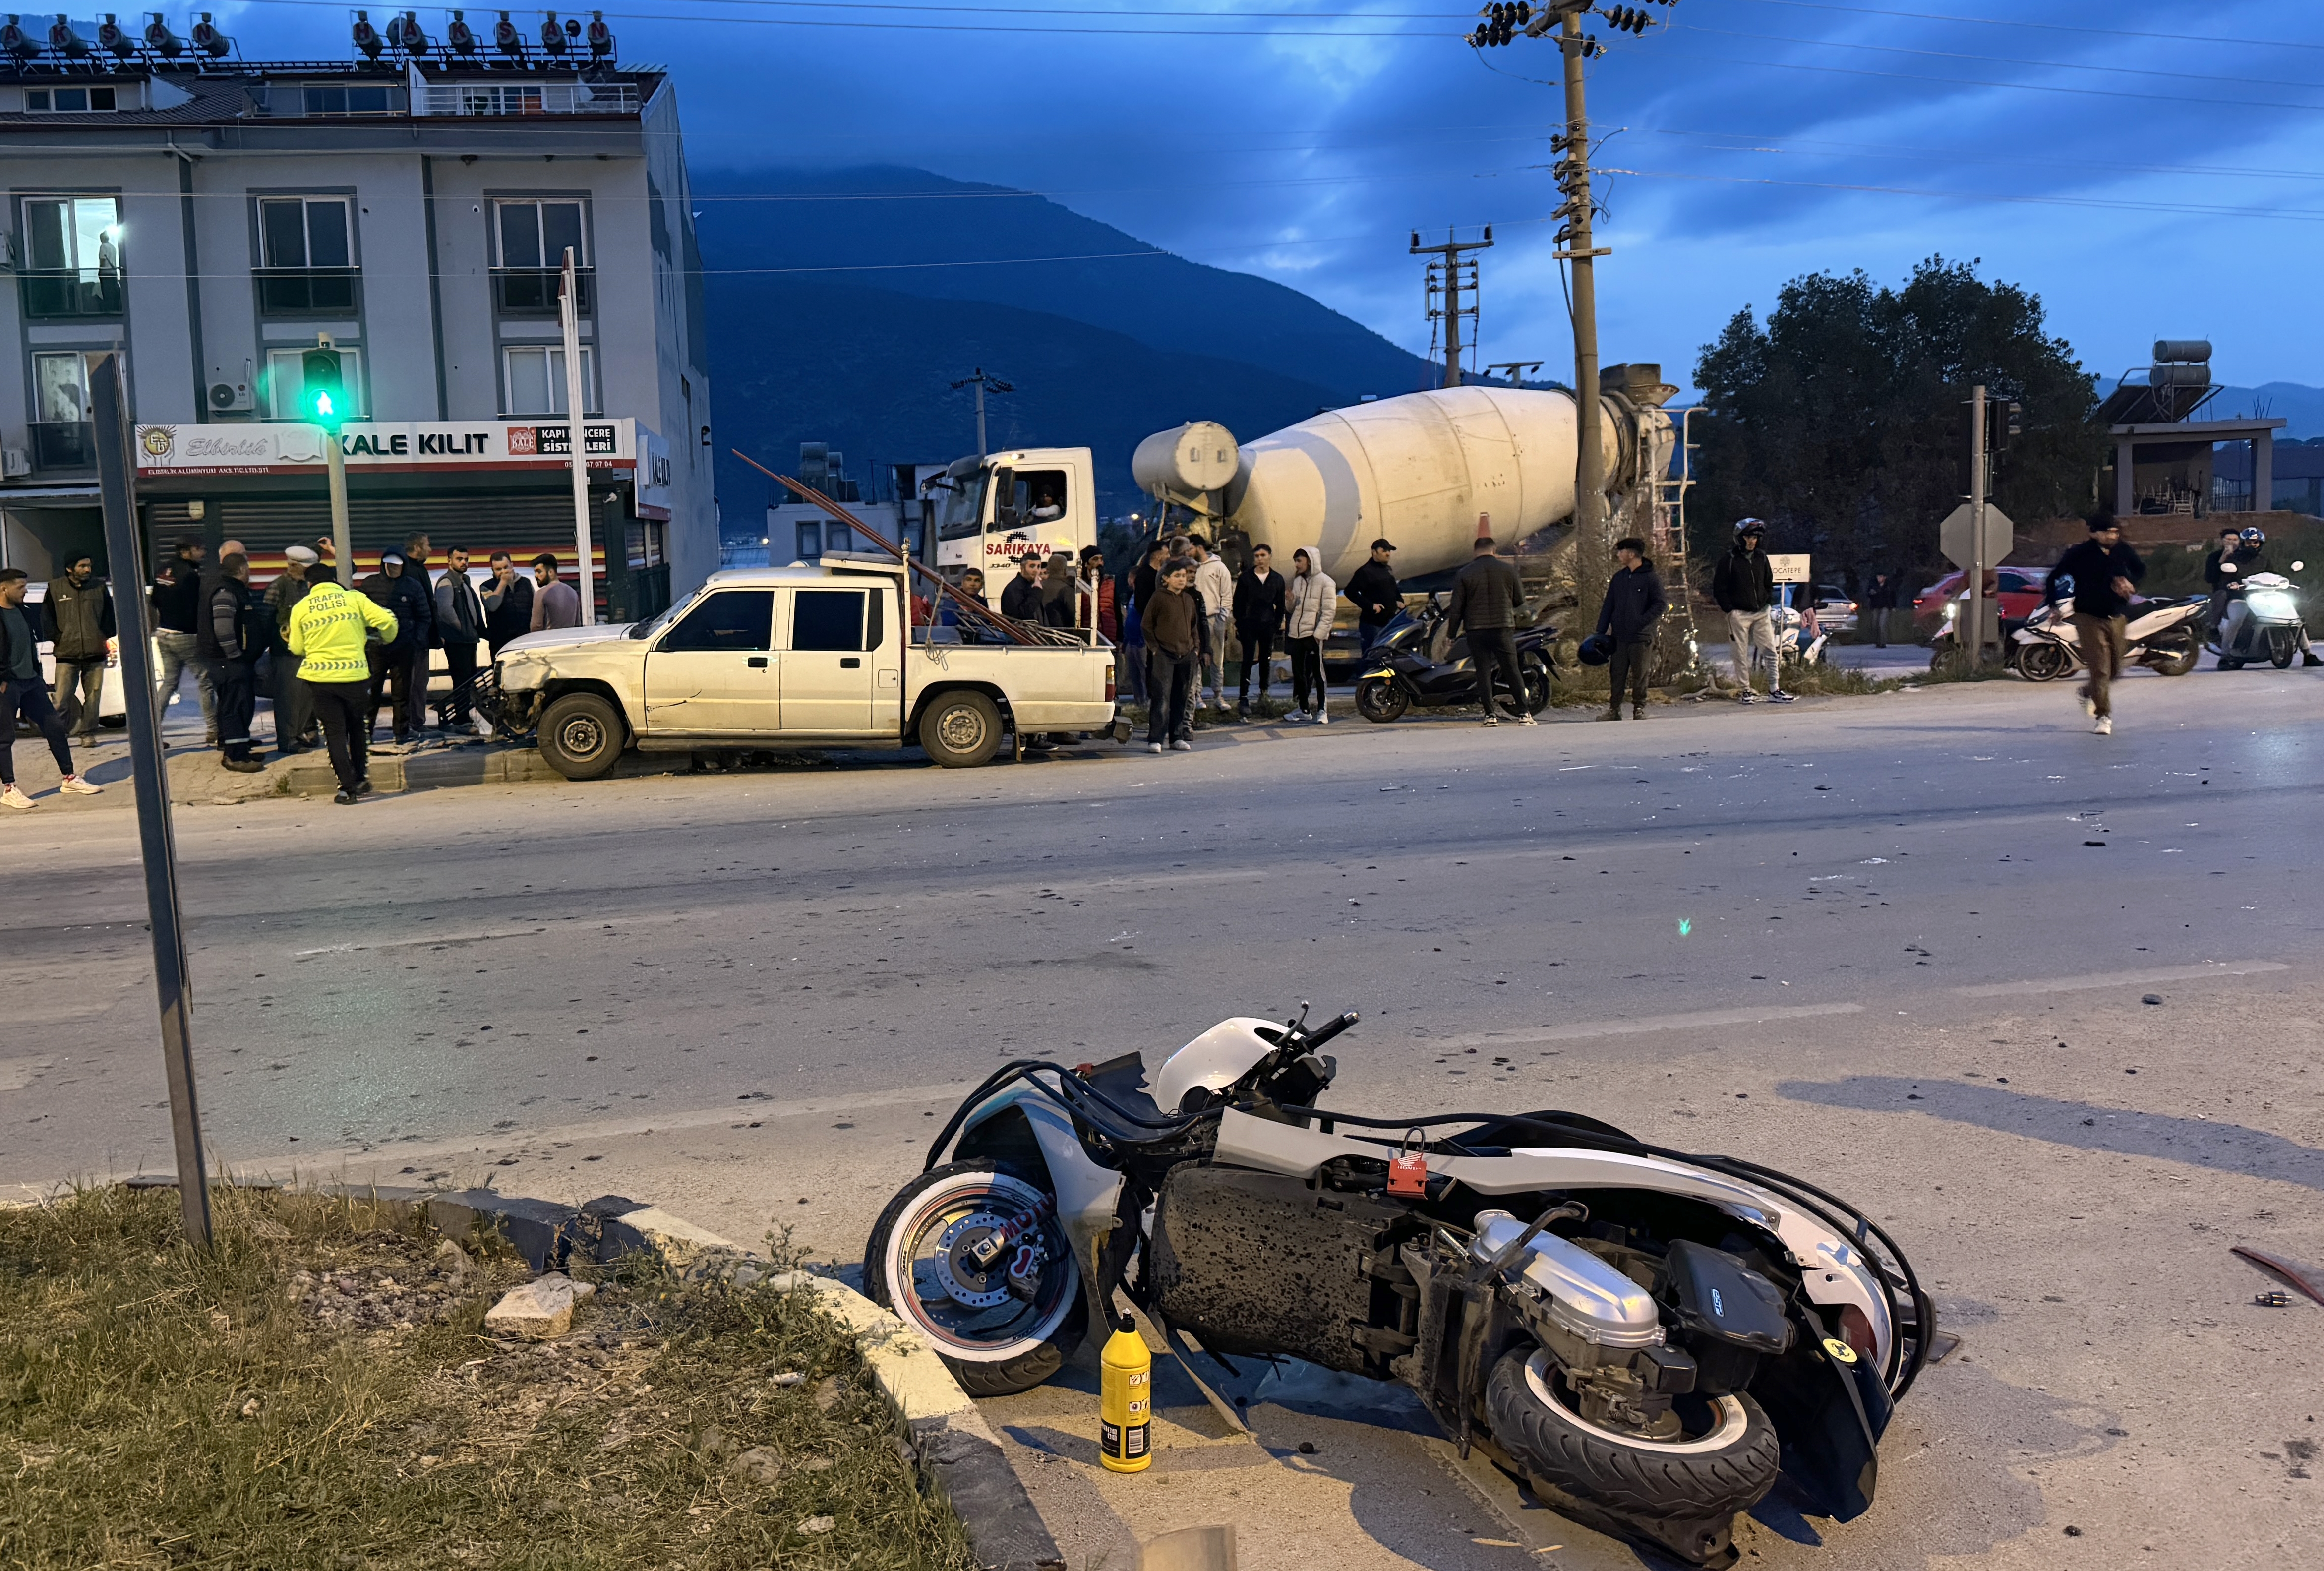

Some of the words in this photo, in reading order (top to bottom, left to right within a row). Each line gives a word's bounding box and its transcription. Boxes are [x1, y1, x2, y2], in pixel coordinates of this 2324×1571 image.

[542, 429, 565, 438] KAPI
[543, 439, 611, 452] SİSTLERİ
[986, 543, 1051, 555] SARIKAYA
[1000, 1190, 1057, 1242] MOTU
